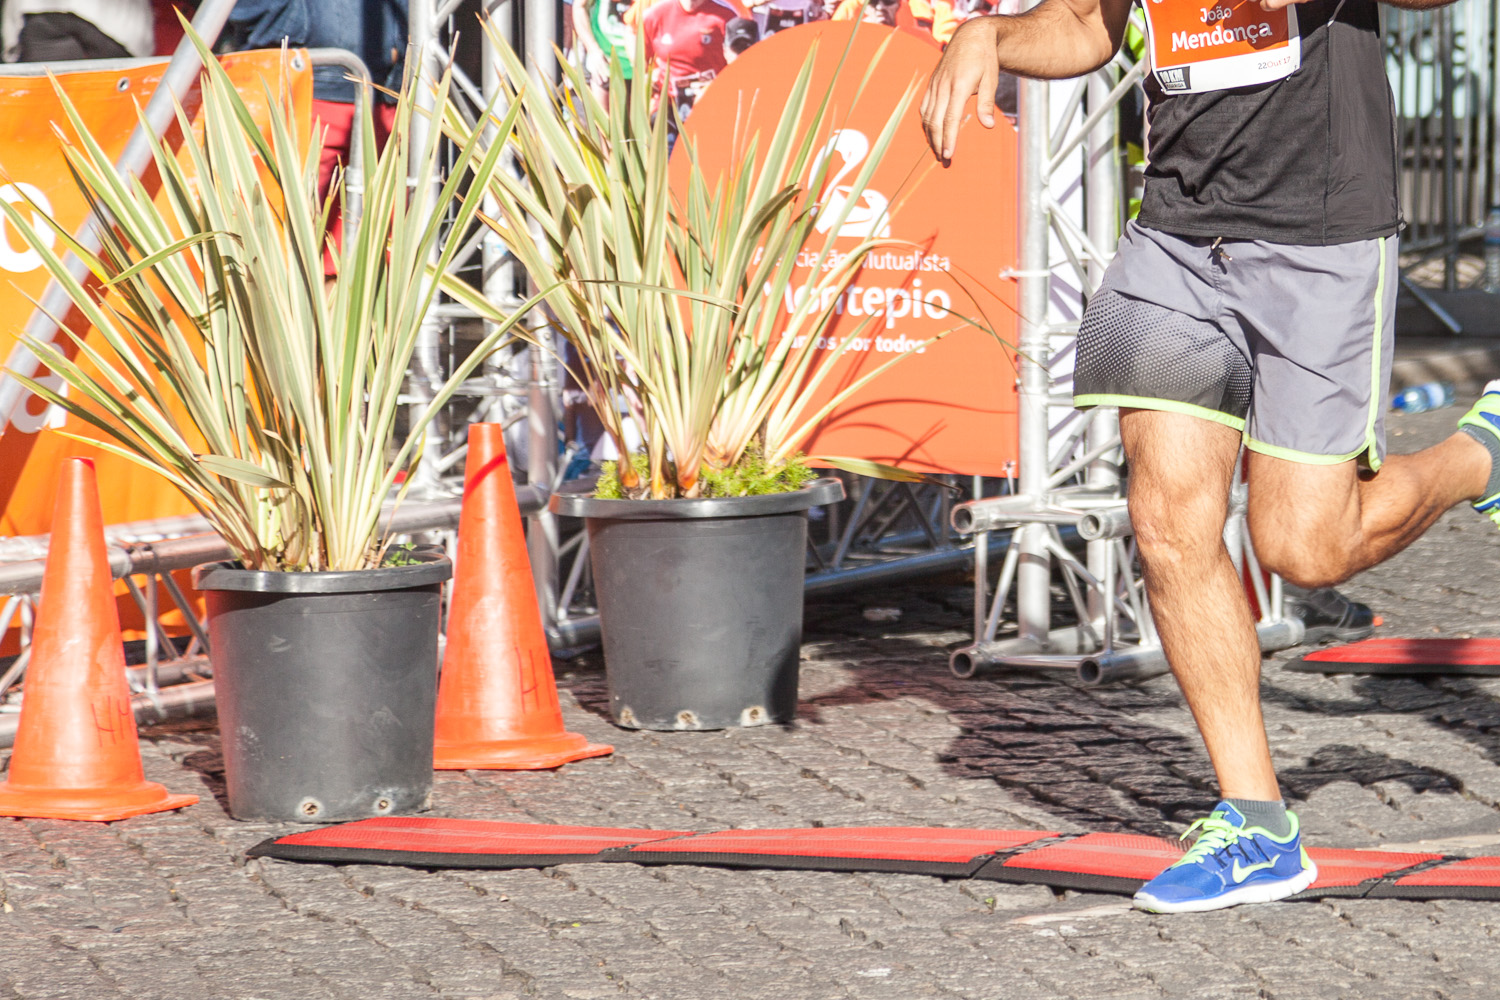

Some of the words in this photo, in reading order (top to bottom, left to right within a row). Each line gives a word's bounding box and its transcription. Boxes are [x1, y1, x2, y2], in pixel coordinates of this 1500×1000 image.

[1200, 4, 1233, 23] João
[1171, 22, 1273, 52] Mendonça
[876, 333, 926, 354] todos
